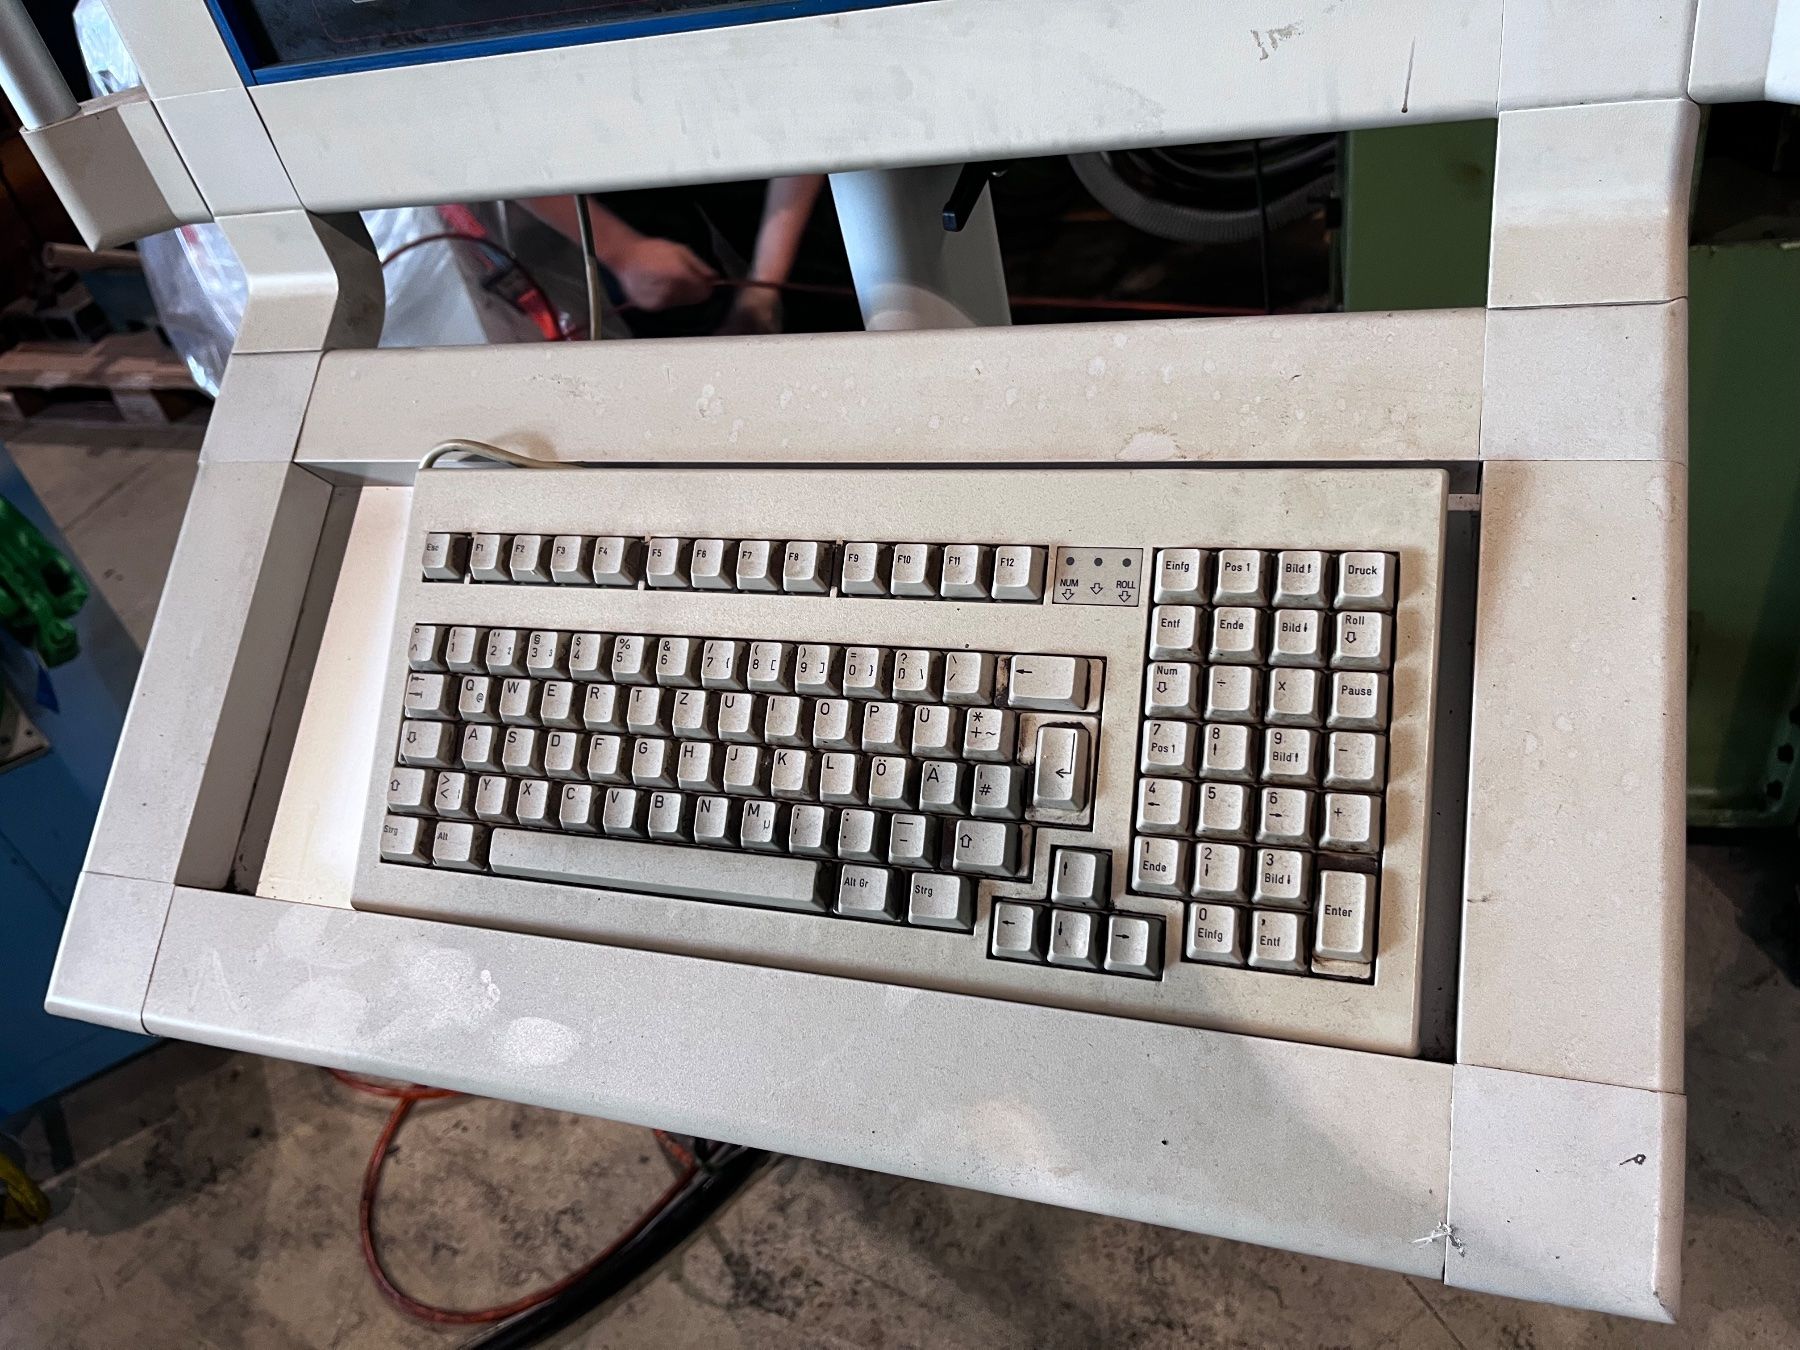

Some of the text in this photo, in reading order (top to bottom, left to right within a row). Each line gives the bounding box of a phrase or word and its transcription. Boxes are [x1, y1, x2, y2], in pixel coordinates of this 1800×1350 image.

[475, 544, 484, 552] F1
[515, 545, 525, 553] F2
[556, 546, 566, 555] F3
[598, 546, 608, 555] F4
[652, 549, 662, 557] F5
[696, 550, 706, 558] F6
[742, 551, 752, 559] F7
[788, 552, 799, 561] F8
[848, 554, 859, 562] F9
[897, 555, 911, 564] F10
[948, 556, 960, 565] F11
[1000, 557, 1014, 567] F12
[1165, 560, 1190, 573] Einfg
[1224, 561, 1243, 572] Pos
[1285, 563, 1305, 574] Bild
[1348, 564, 1378, 575] Druck
[1060, 579, 1079, 587] NUM
[1116, 580, 1136, 589] ROLL
[1160, 618, 1181, 628] Entf
[1219, 619, 1244, 630] Ende
[1345, 614, 1365, 626] Roll
[1281, 622, 1302, 633] Bild
[575, 636, 582, 646] $
[619, 638, 631, 650] %
[663, 640, 671, 652] &
[490, 645, 498, 656] 2
[531, 647, 538, 658] 3
[707, 642, 714, 654] /
[754, 644, 760, 655] (
[801, 647, 807, 659] )
[573, 650, 580, 660] 4
[616, 651, 623, 663] 5
[661, 654, 668, 665] 6
[900, 653, 908, 665] ?
[706, 656, 714, 668] 7
[752, 658, 777, 671] 8 [
[800, 661, 825, 674] 9 ]
[1156, 665, 1178, 676] Num
[465, 679, 475, 691] Q
[507, 681, 520, 694] W
[547, 684, 557, 697] E
[1341, 684, 1373, 696] Pause
[590, 687, 600, 700] R
[635, 689, 642, 702] T
[679, 692, 690, 705] Z
[724, 695, 735, 709] U
[820, 702, 830, 716] O
[869, 705, 880, 718] P
[919, 707, 930, 723] Ü
[468, 728, 478, 741] A
[970, 726, 982, 738] +
[1153, 723, 1161, 736] 7
[1212, 727, 1220, 740] 8
[507, 731, 518, 744] S
[551, 734, 561, 747] D
[594, 737, 605, 750] F
[1274, 731, 1283, 745] 9
[638, 741, 648, 754] G
[683, 745, 694, 758] H
[1151, 742, 1169, 753] Pos
[729, 748, 739, 762] J
[777, 751, 788, 766] K
[1272, 751, 1292, 762] Bild
[826, 755, 835, 770] L
[876, 759, 887, 776] Ö
[926, 763, 940, 783] Ä
[441, 774, 450, 785] >
[483, 778, 491, 791] Y
[440, 788, 450, 799] <
[522, 782, 533, 796] X
[566, 787, 576, 800] C
[979, 783, 993, 796] #
[1148, 781, 1156, 794] 4
[1207, 786, 1217, 800] 5
[611, 790, 620, 804] V
[654, 794, 664, 809] B
[1269, 791, 1278, 805] 6
[700, 799, 711, 813] N
[747, 803, 761, 818] M
[1333, 807, 1343, 817] +
[437, 832, 449, 841] Alt
[1145, 841, 1150, 854] 1
[1204, 847, 1213, 860] 2
[1265, 853, 1274, 866] 3
[1142, 860, 1167, 872] Ende
[843, 877, 869, 888] Alt Gr
[1264, 872, 1285, 884] Bild
[914, 884, 934, 898] Strg
[1324, 904, 1353, 917] Enter
[1197, 927, 1223, 943] Einfg
[1260, 935, 1281, 947] Entf
